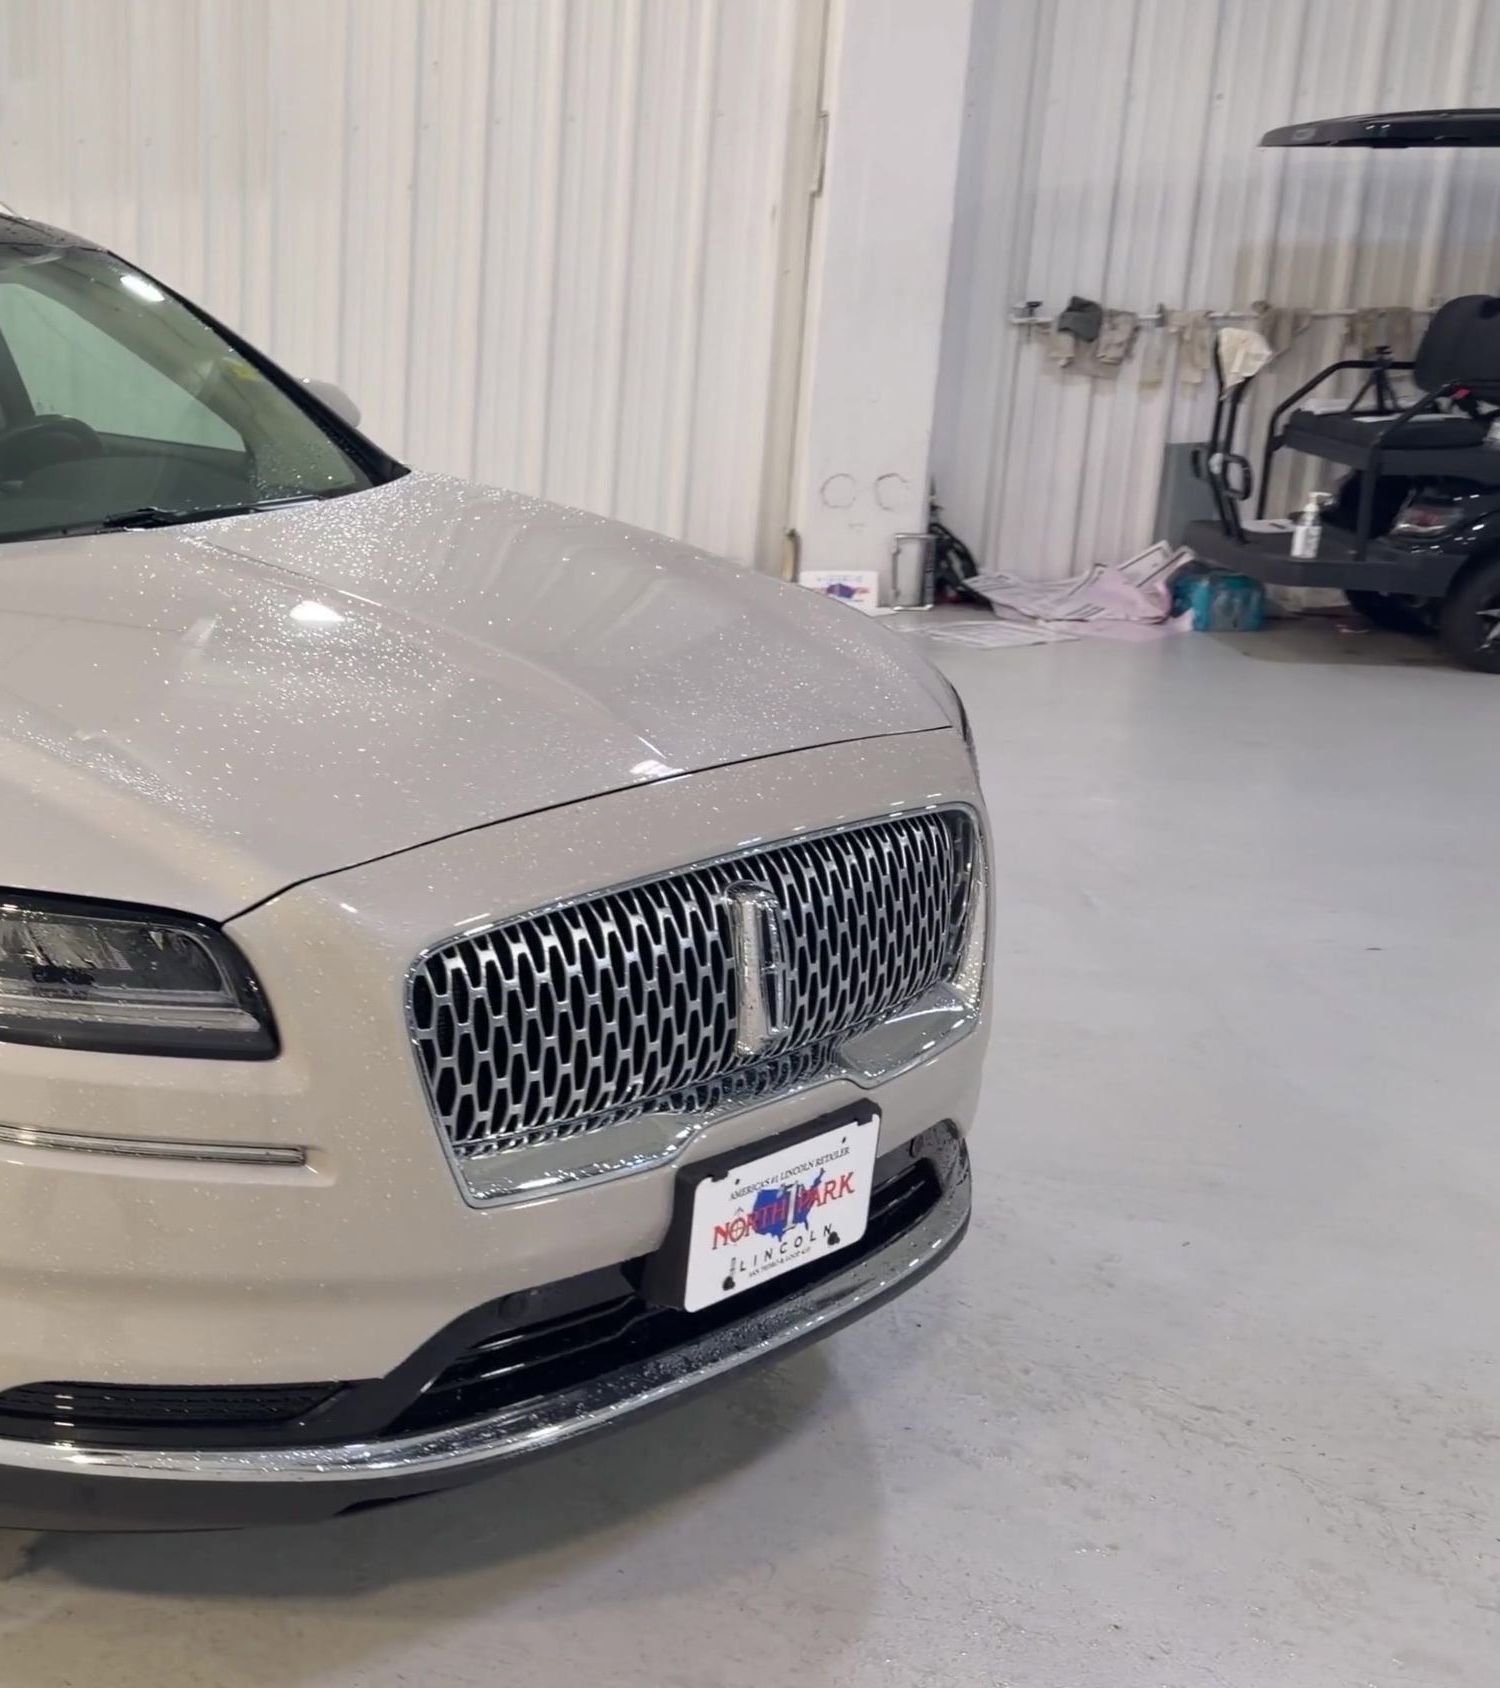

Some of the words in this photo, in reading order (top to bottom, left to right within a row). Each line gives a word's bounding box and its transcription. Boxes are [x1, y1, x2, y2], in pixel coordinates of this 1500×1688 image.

[780, 1160, 815, 1181] LINCOLN
[815, 1147, 850, 1167] RETAILER
[712, 1201, 790, 1250] NORTH
[796, 1171, 855, 1214] PARK
[739, 1223, 833, 1272] LINCOLN
